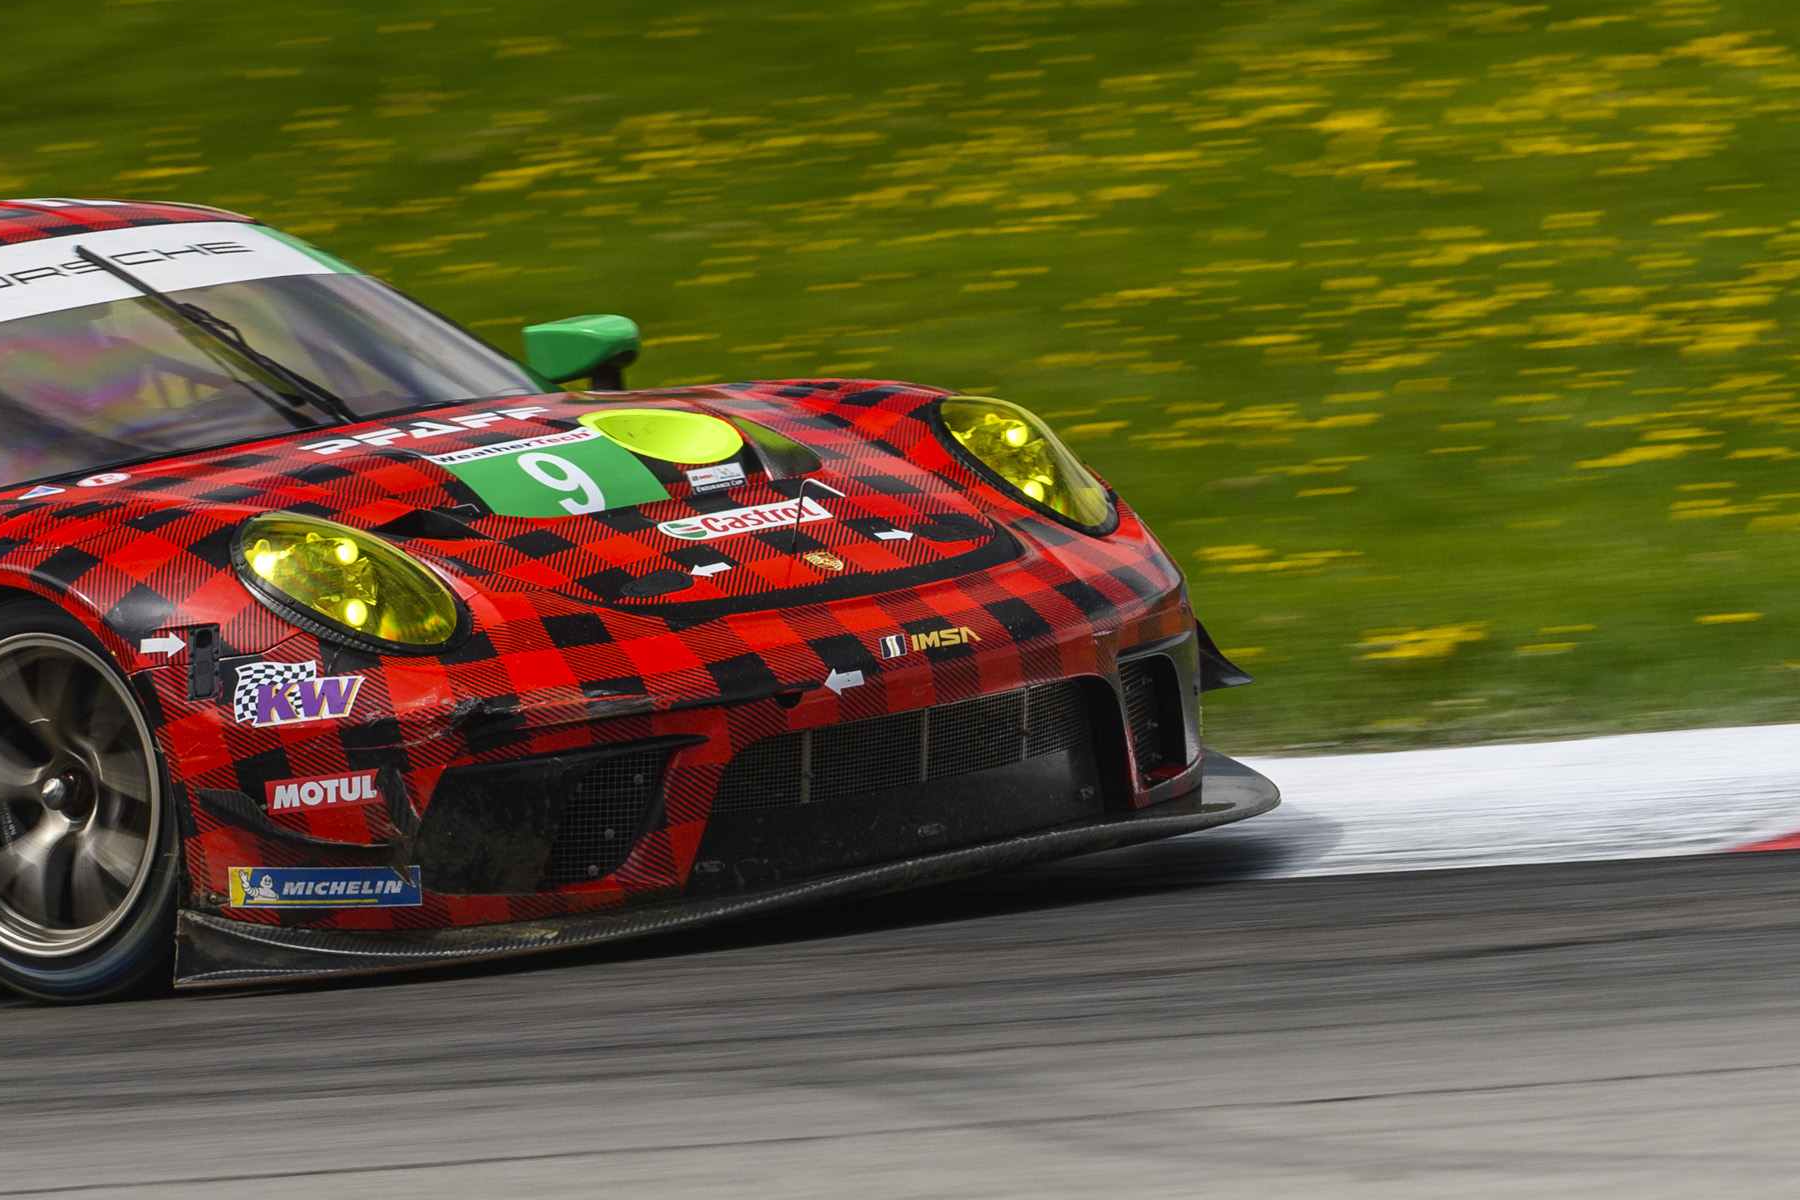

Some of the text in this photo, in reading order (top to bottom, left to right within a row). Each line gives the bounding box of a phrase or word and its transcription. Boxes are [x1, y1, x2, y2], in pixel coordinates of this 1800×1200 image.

[297, 415, 550, 456] PFAFF
[434, 431, 592, 463] WeatherTech
[517, 452, 606, 516] 9
[700, 502, 822, 533] Castrol
[911, 626, 982, 652] IMSA
[256, 677, 362, 725] KW
[273, 775, 377, 810] MOTUL
[282, 880, 403, 896] MICHELIN
